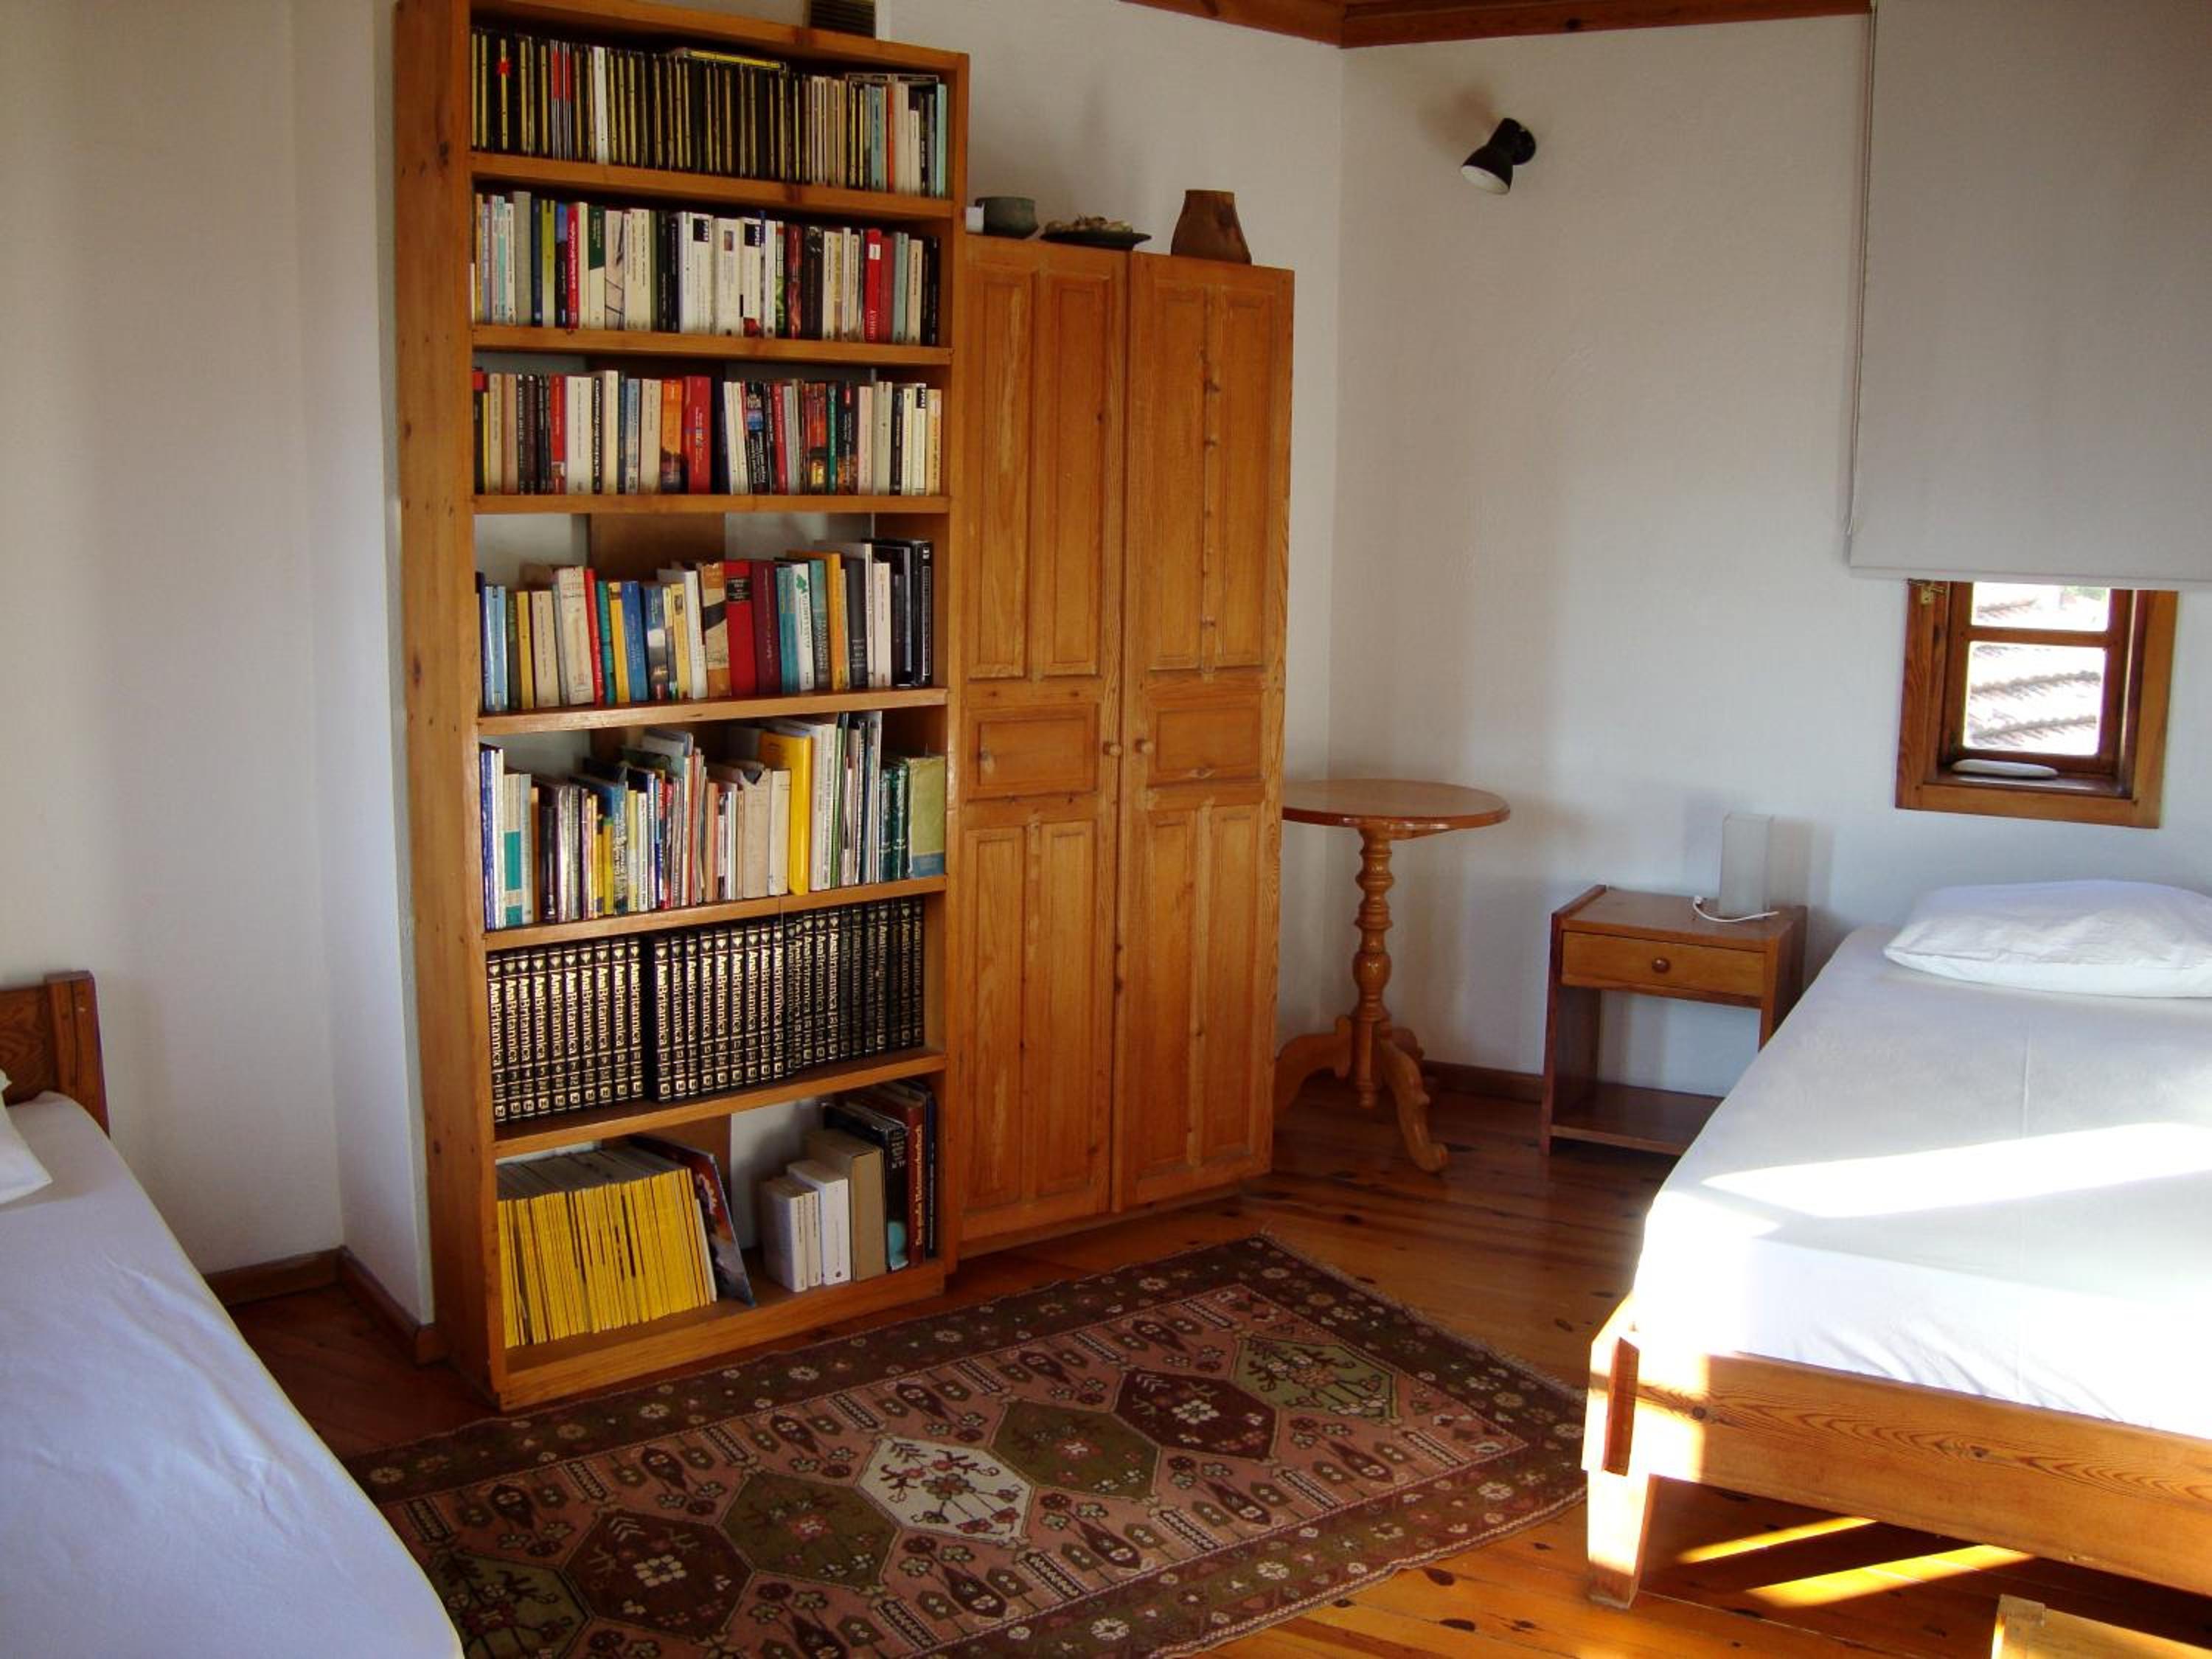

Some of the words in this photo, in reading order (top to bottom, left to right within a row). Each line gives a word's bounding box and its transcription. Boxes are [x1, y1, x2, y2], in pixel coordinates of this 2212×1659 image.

[490, 983, 502, 1067] AnaBritannica
[506, 980, 517, 1063] AnaBritannica
[519, 978, 530, 1061] AnaBritannica
[535, 977, 545, 1058] AnaBritannica
[552, 974, 563, 1057] AnaBritannica
[566, 972, 577, 1054] AnaBritannica
[581, 970, 592, 1051] AnaBritannica
[598, 967, 608, 1048] AnaBritannica
[614, 966, 625, 1046] AnaBritannica
[630, 963, 641, 1044] AnaBritannica
[657, 965, 669, 1046] AnaBritannica
[673, 961, 683, 1042] AnaBritannica
[688, 961, 697, 1042] AnaBritannica
[703, 958, 712, 1037] AnaBritannica
[718, 956, 727, 1034] AnaBritannica
[733, 953, 742, 1033] AnaBritannica
[748, 951, 757, 1030] AnaBritannica
[762, 948, 771, 1028] AnaBritannica
[774, 947, 784, 1026] AnaBritannica
